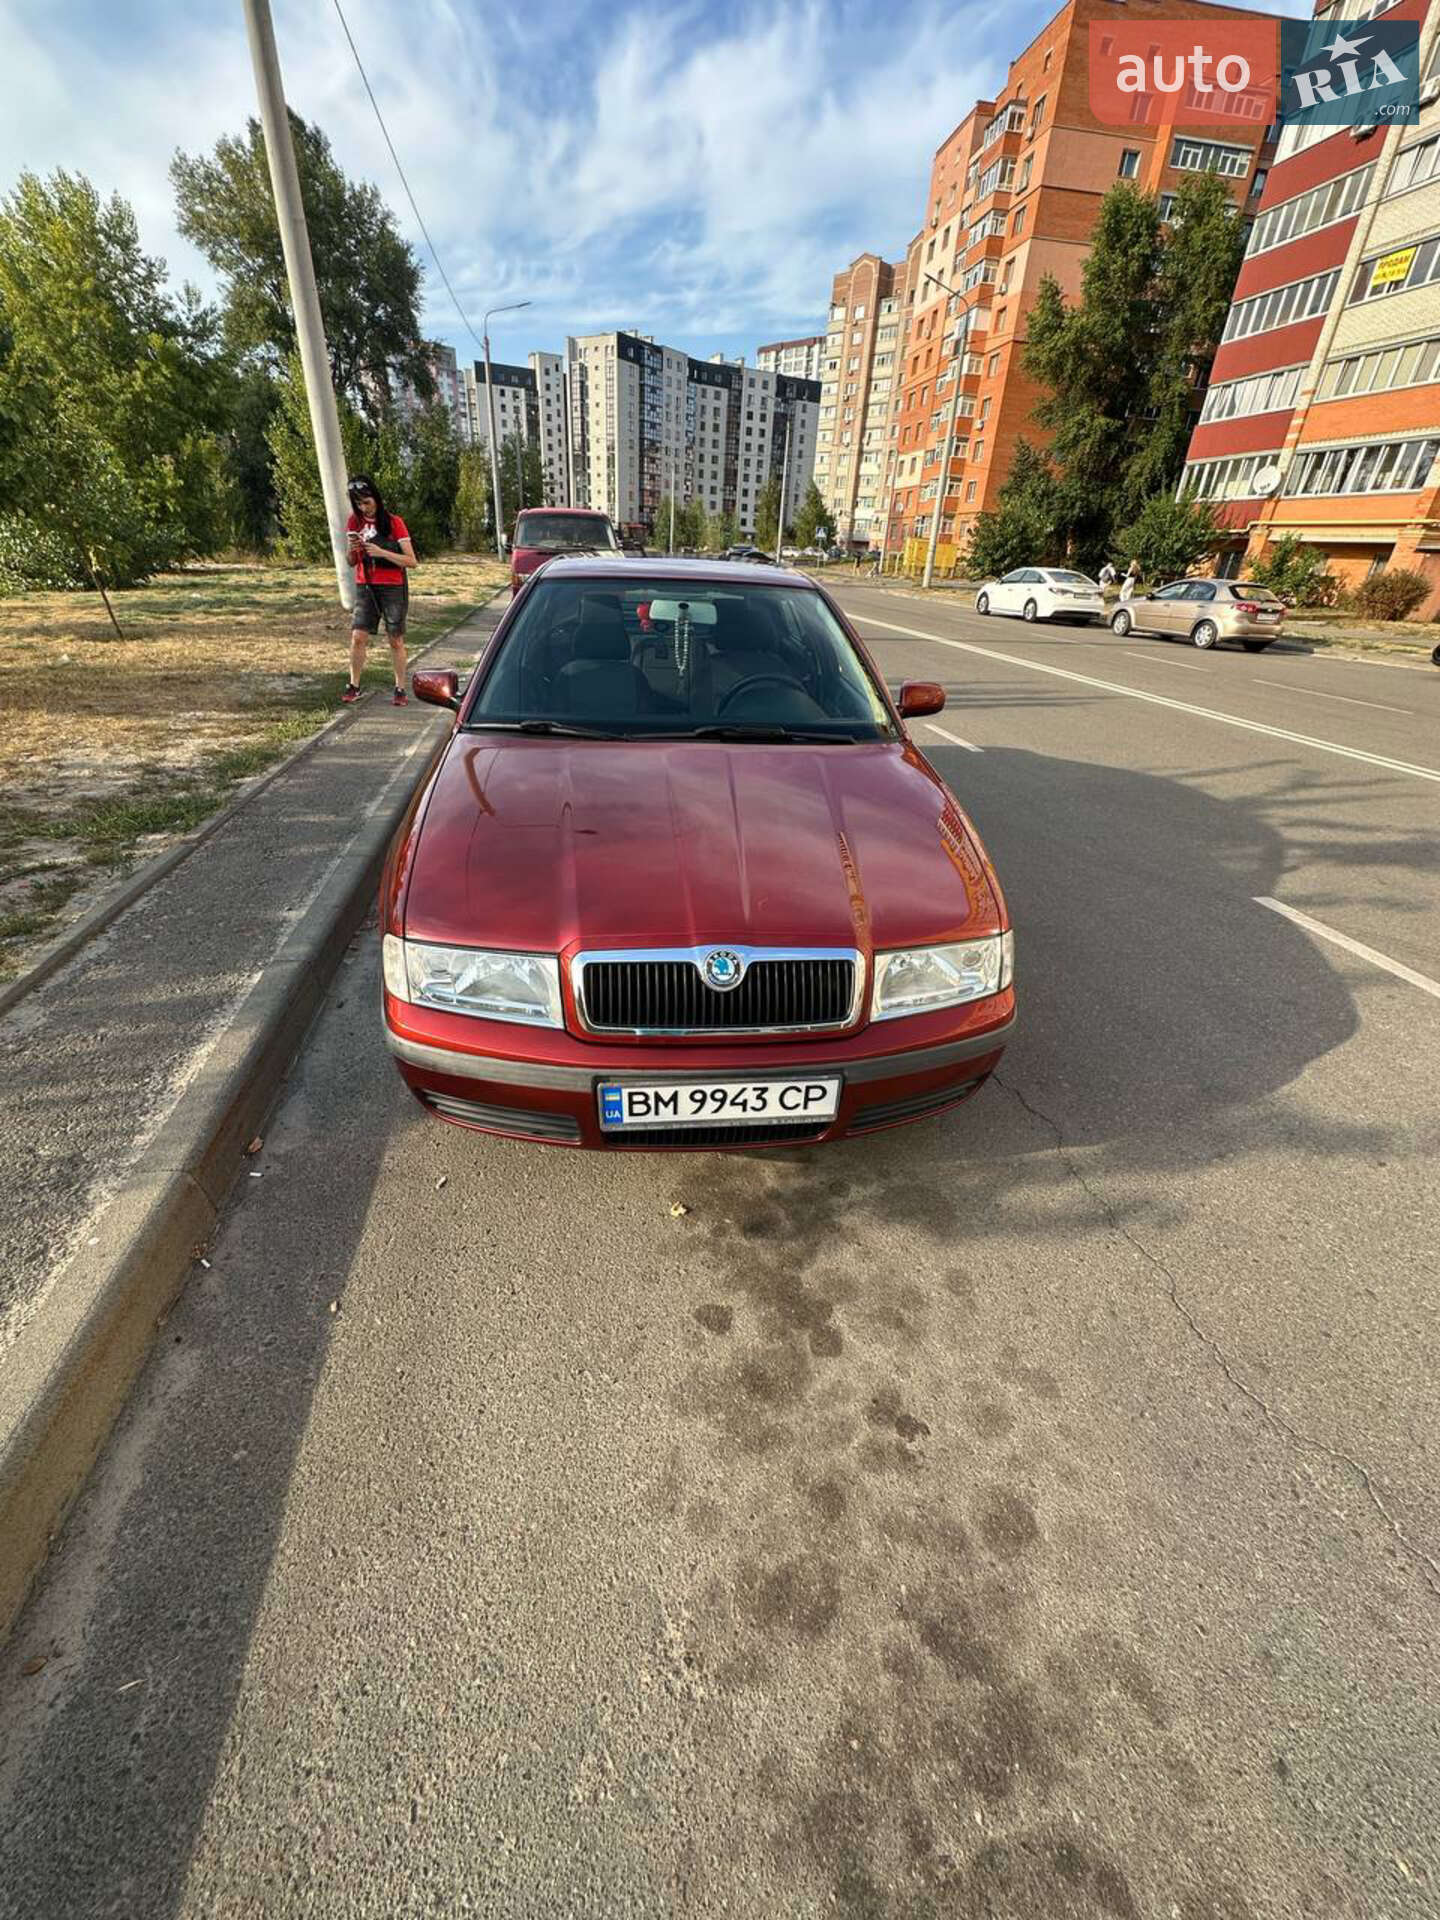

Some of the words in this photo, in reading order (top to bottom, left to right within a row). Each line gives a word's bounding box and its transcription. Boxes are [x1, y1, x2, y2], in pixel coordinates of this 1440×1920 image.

[628, 1090, 679, 1117] BM
[689, 1087, 768, 1114] 9943
[779, 1085, 828, 1110] CP
[606, 1110, 621, 1119] UA
